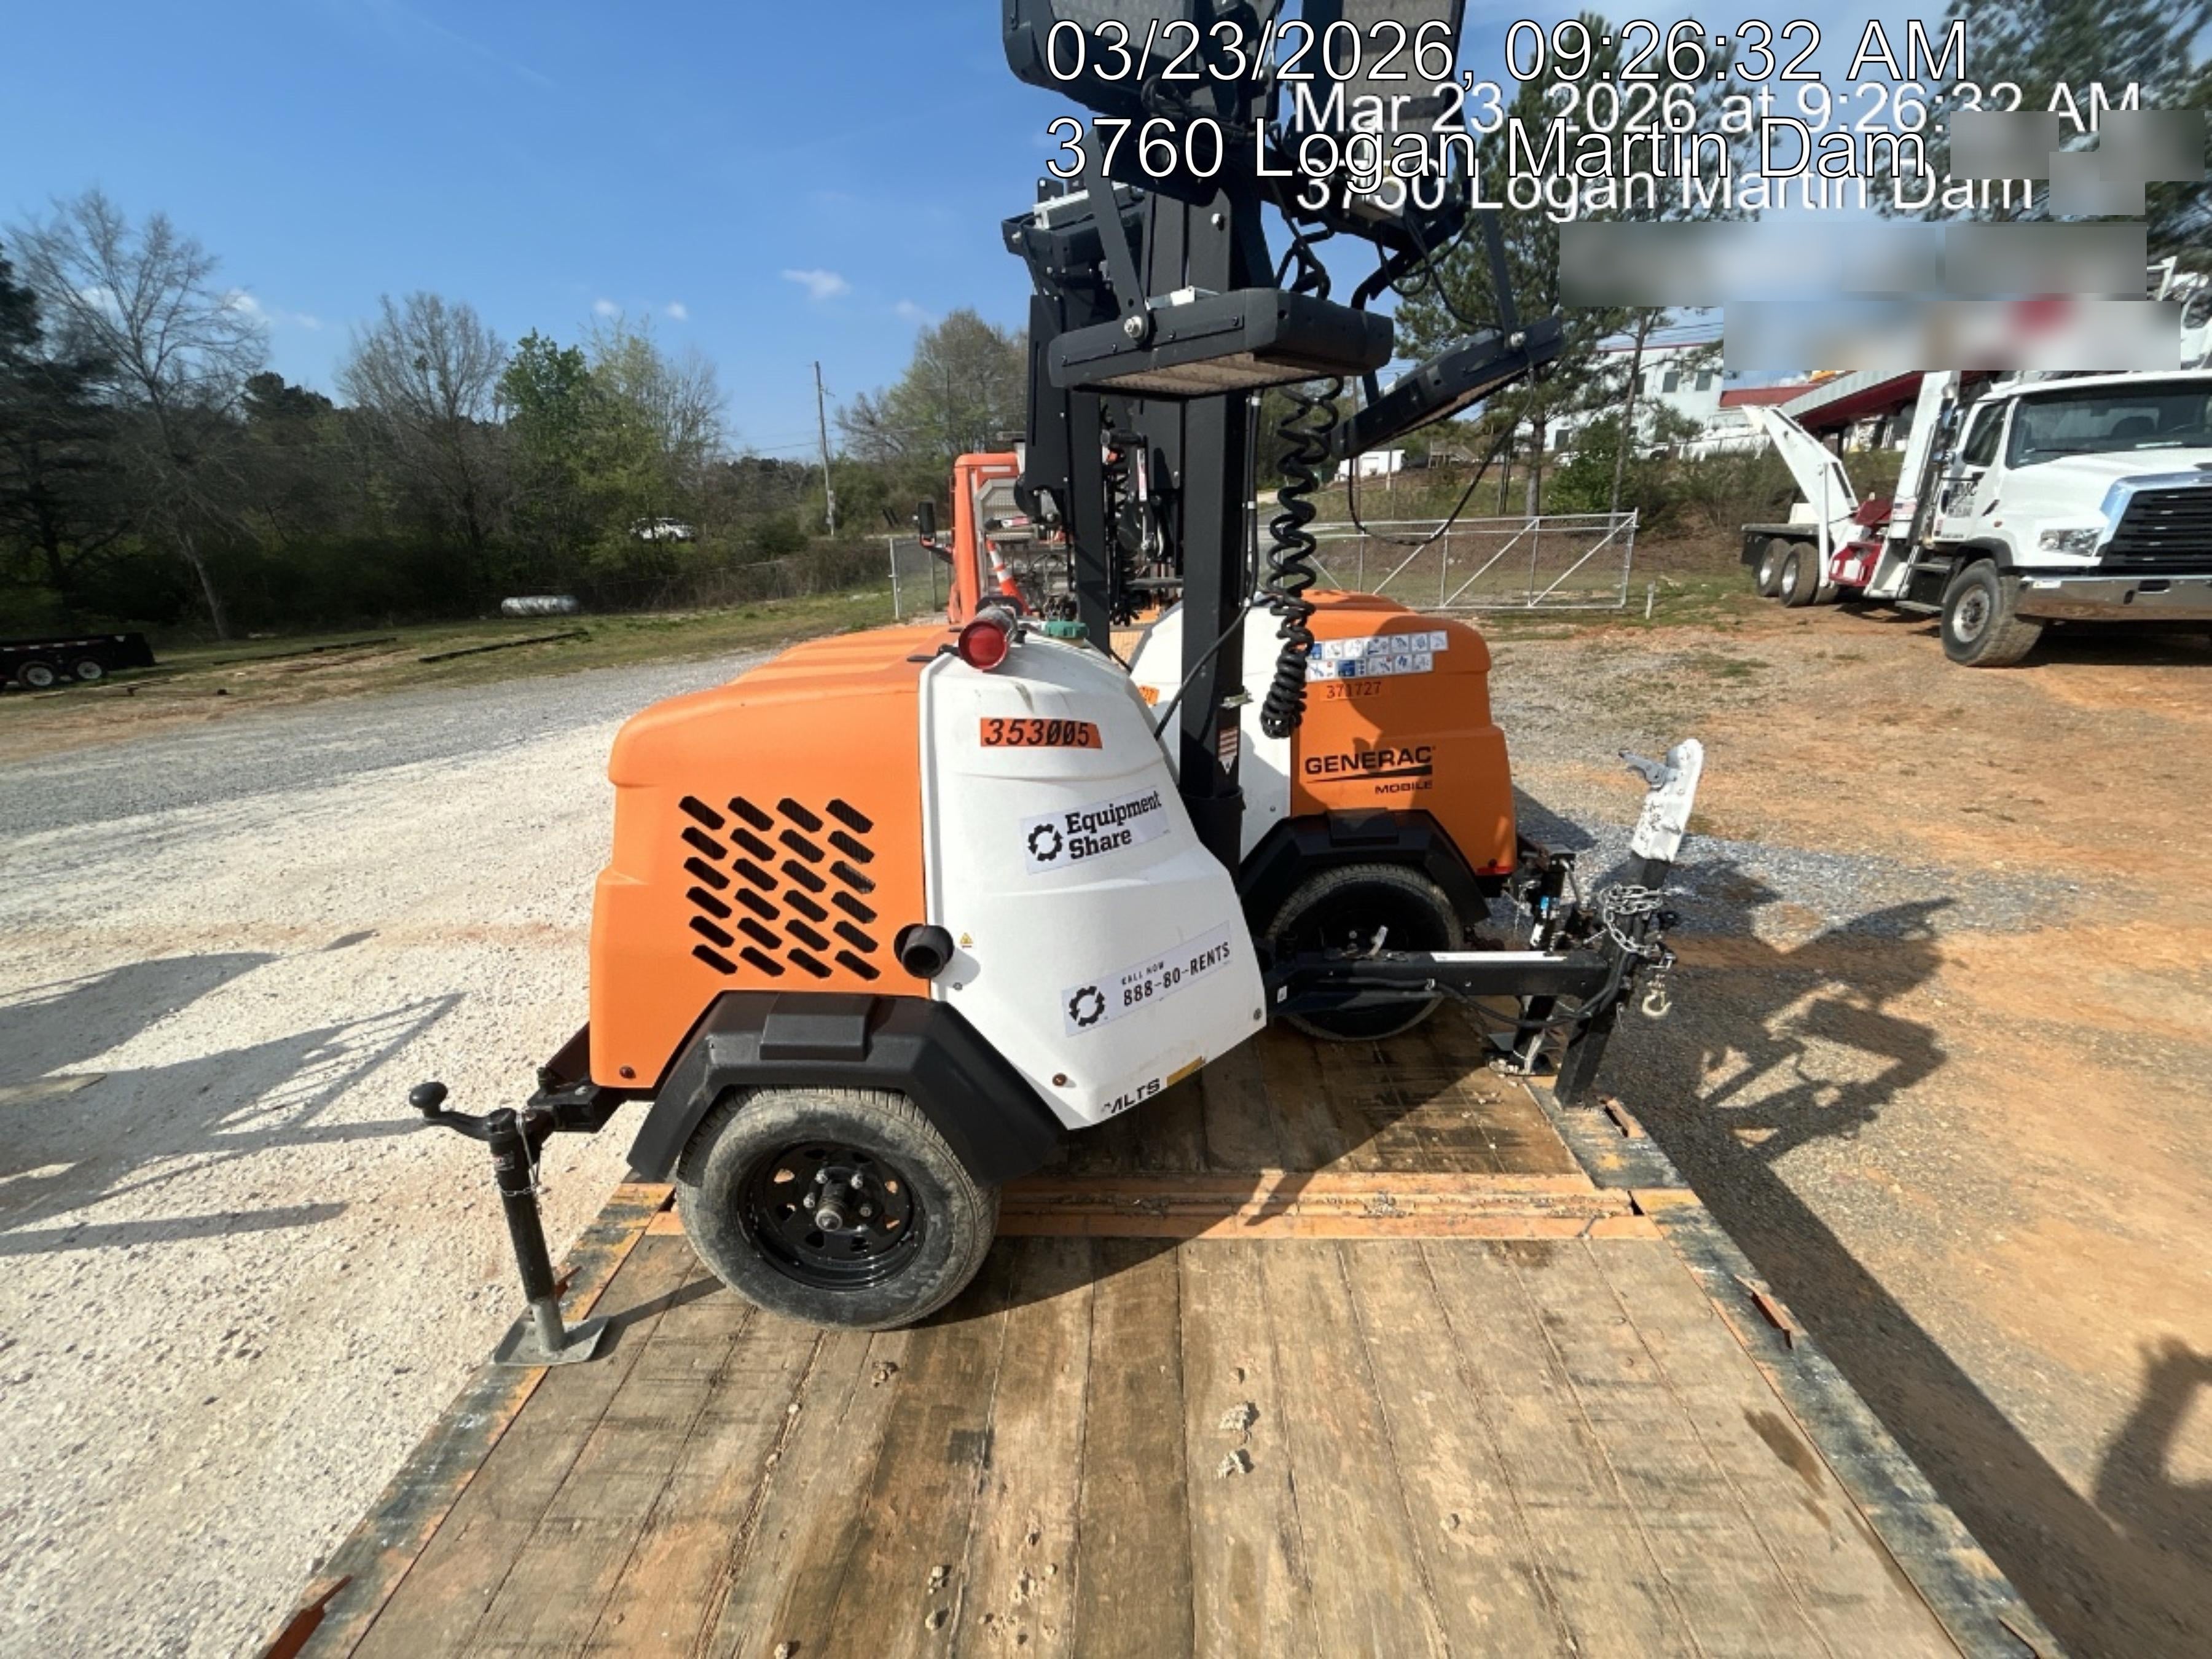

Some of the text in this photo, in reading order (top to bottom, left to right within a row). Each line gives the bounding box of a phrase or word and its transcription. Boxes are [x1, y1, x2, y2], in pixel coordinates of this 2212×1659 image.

[1325, 681, 1382, 700] 371727
[985, 718, 1091, 745] 353005
[1304, 745, 1432, 775] GENERAC
[1375, 780, 1433, 795] MOBILE
[1065, 790, 1163, 834] Equipment
[1069, 829, 1133, 860] Share
[1121, 960, 1164, 985] CALL NOW
[1123, 941, 1230, 1006] 888-80-RENTS
